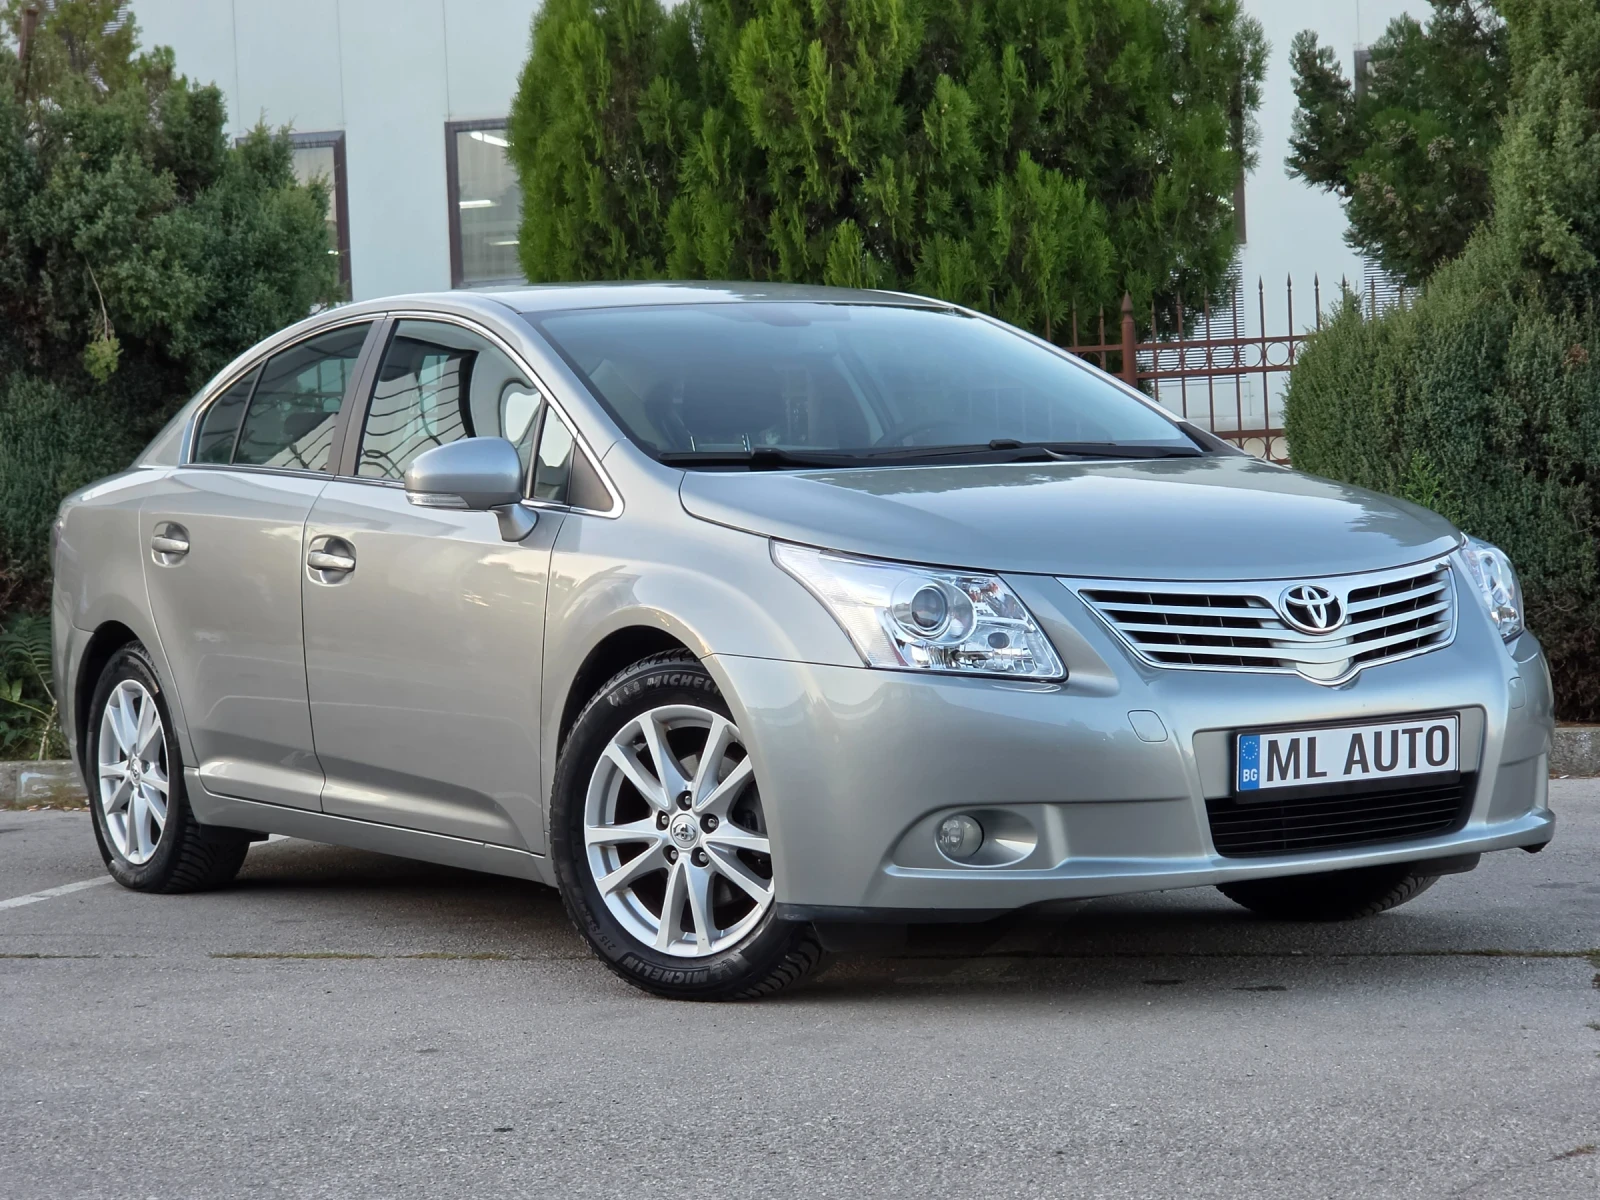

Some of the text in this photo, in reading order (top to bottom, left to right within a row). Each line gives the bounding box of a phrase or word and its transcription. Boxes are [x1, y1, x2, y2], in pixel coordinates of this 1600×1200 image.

[645, 674, 722, 697] MICHELI
[1266, 725, 1449, 782] ML AUTO
[1243, 769, 1258, 782] BG
[622, 956, 709, 984] MICHELIN
